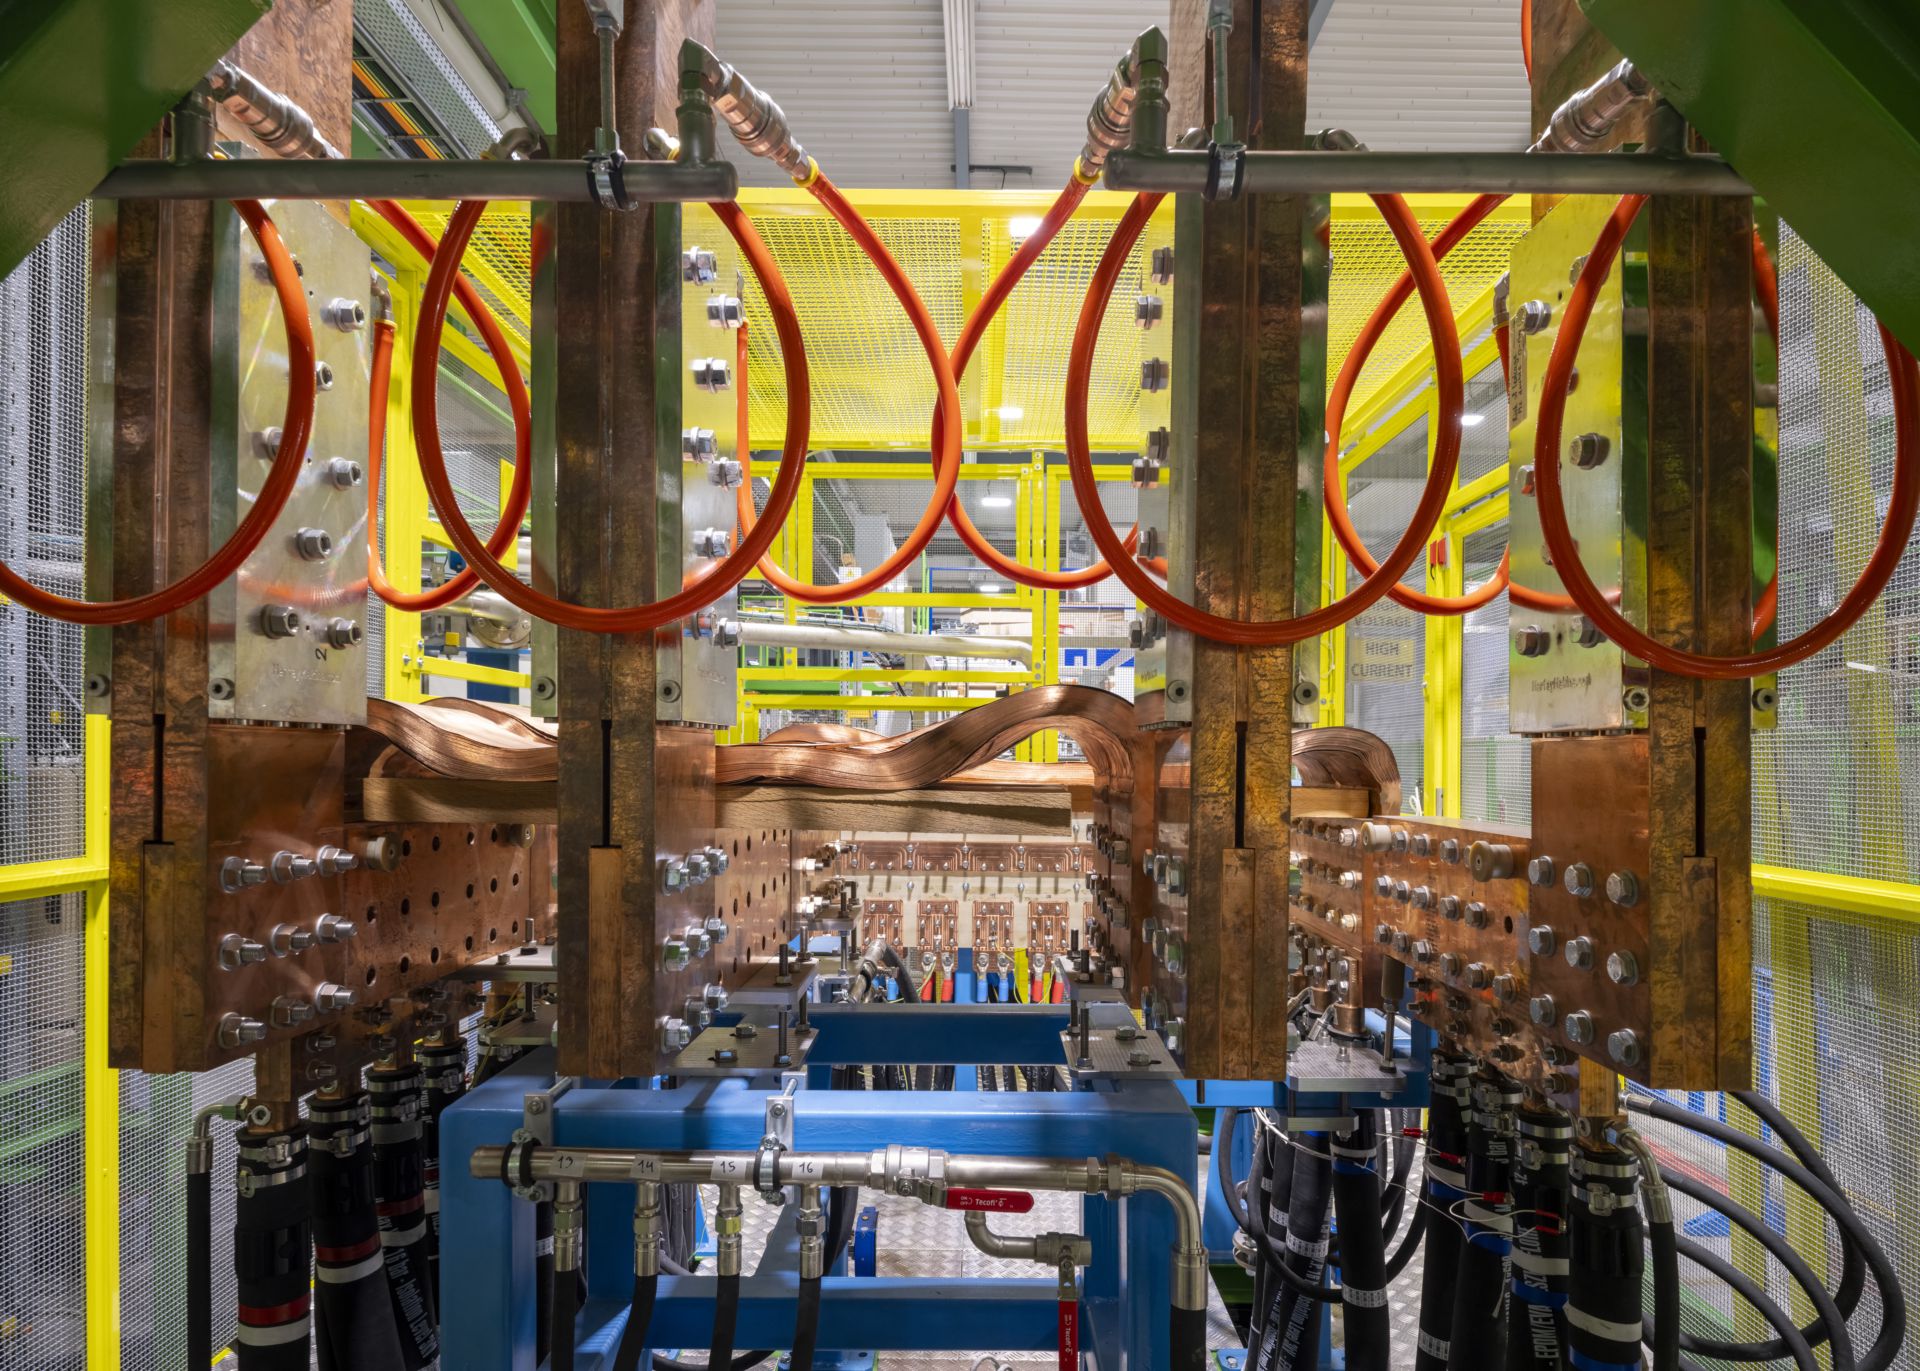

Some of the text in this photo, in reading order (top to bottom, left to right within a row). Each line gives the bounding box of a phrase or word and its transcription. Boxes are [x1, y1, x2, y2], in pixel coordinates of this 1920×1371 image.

[1354, 616, 1411, 627] VOLTAGE
[314, 647, 327, 662] 2
[1365, 642, 1400, 655] HIGH
[1351, 664, 1413, 677] CURRENT
[637, 1159, 655, 1173] 14
[720, 1160, 736, 1173] 15
[798, 1161, 814, 1174] 16
